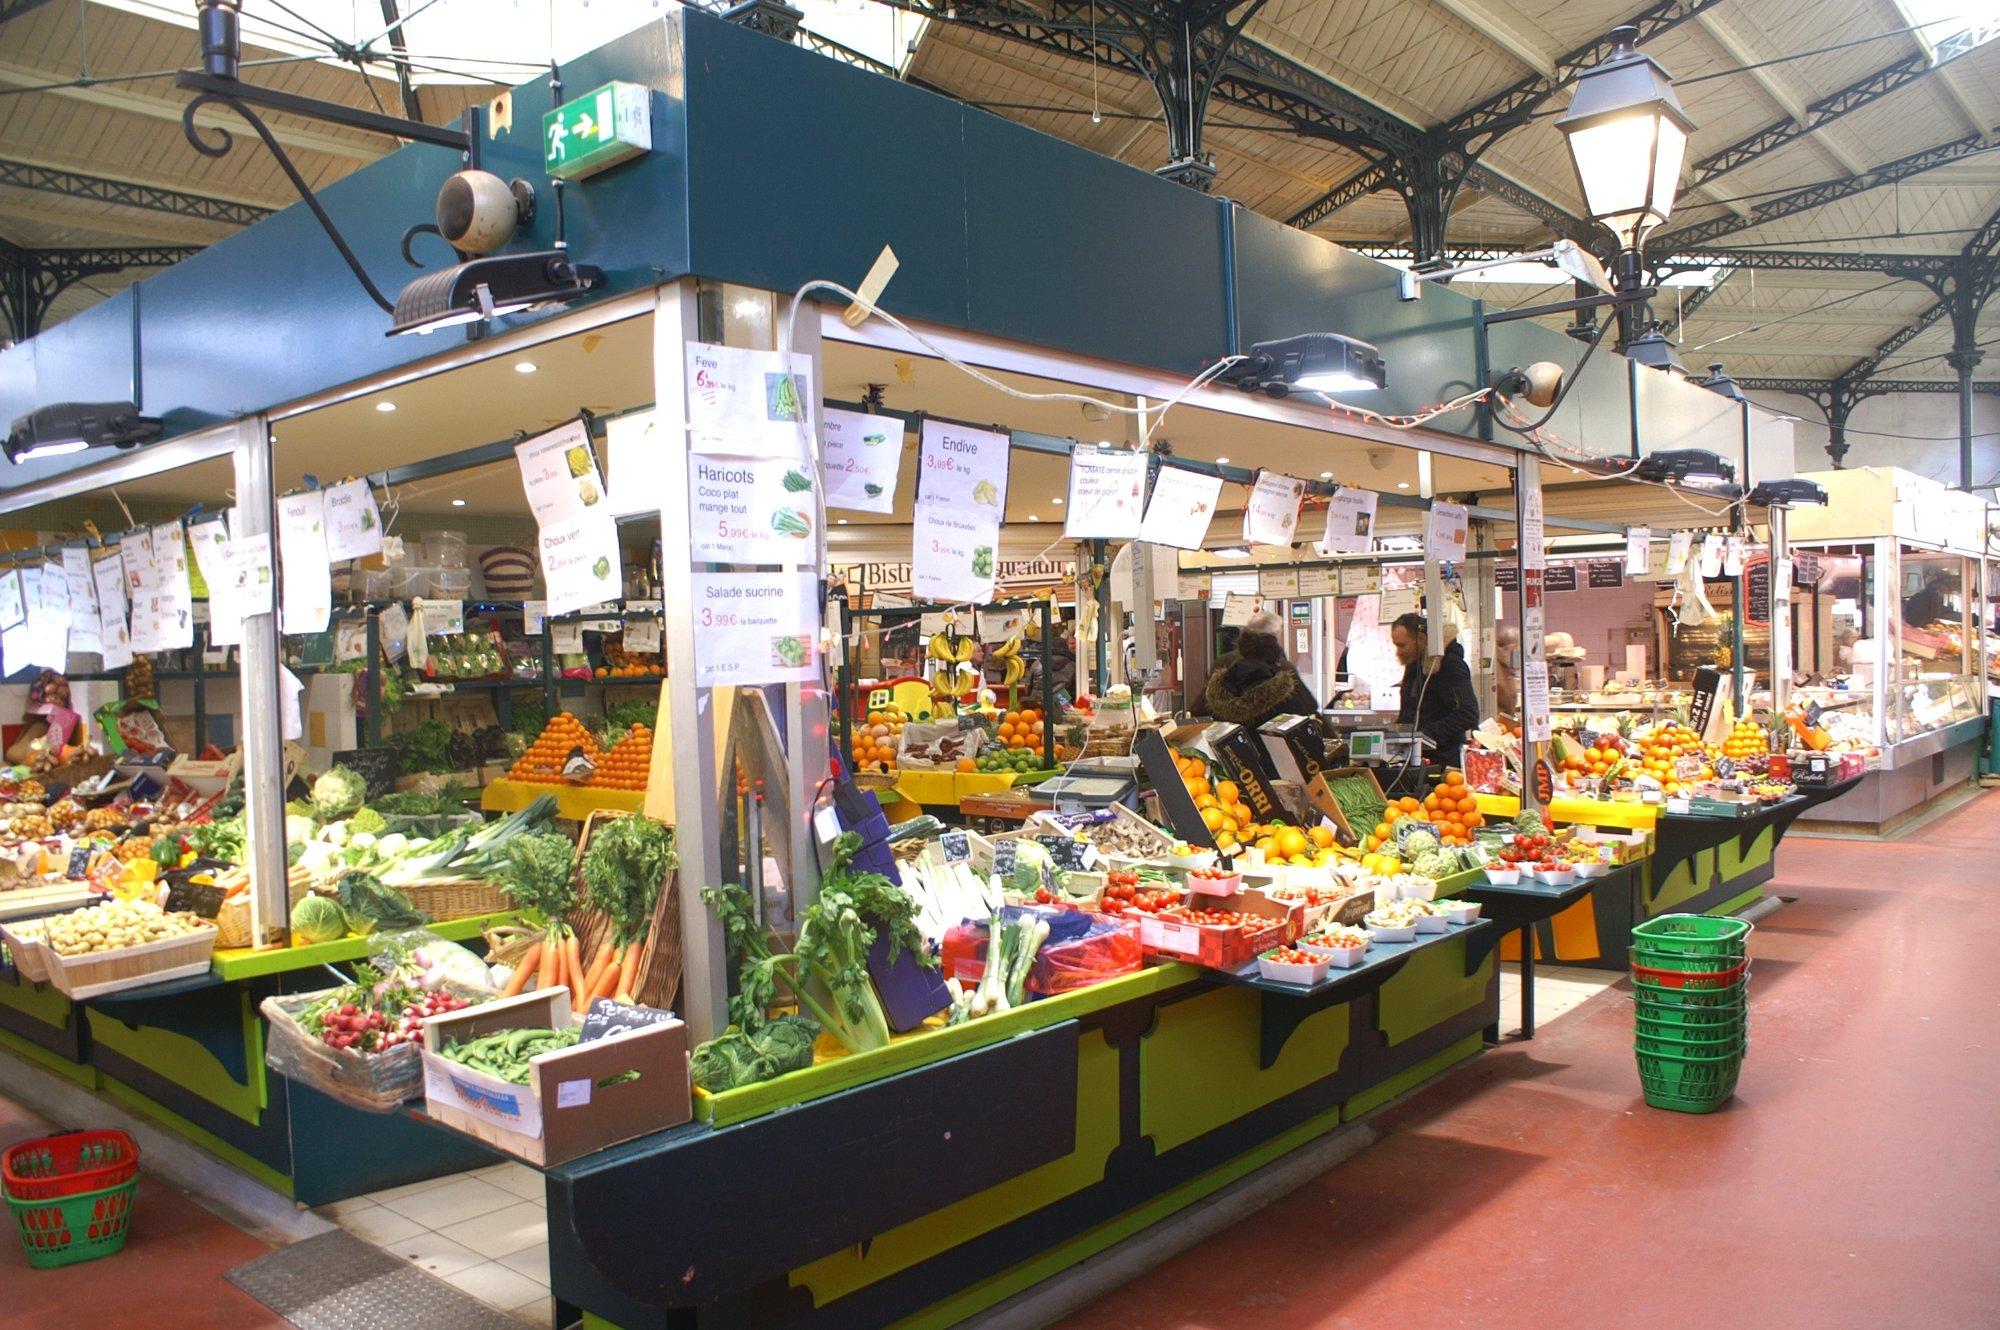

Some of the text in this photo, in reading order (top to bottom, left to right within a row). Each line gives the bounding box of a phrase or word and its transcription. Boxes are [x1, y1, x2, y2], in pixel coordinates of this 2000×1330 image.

[943, 436, 978, 455] Endive
[698, 465, 755, 484] Haricots
[964, 465, 971, 475] kg
[699, 486, 739, 500] Coco plat
[700, 503, 747, 515] mange tout
[719, 520, 749, 540] 5,99€
[706, 586, 784, 598] Salade sucrine
[702, 607, 738, 628] 3,99€
[1239, 768, 1273, 816] ORRI
